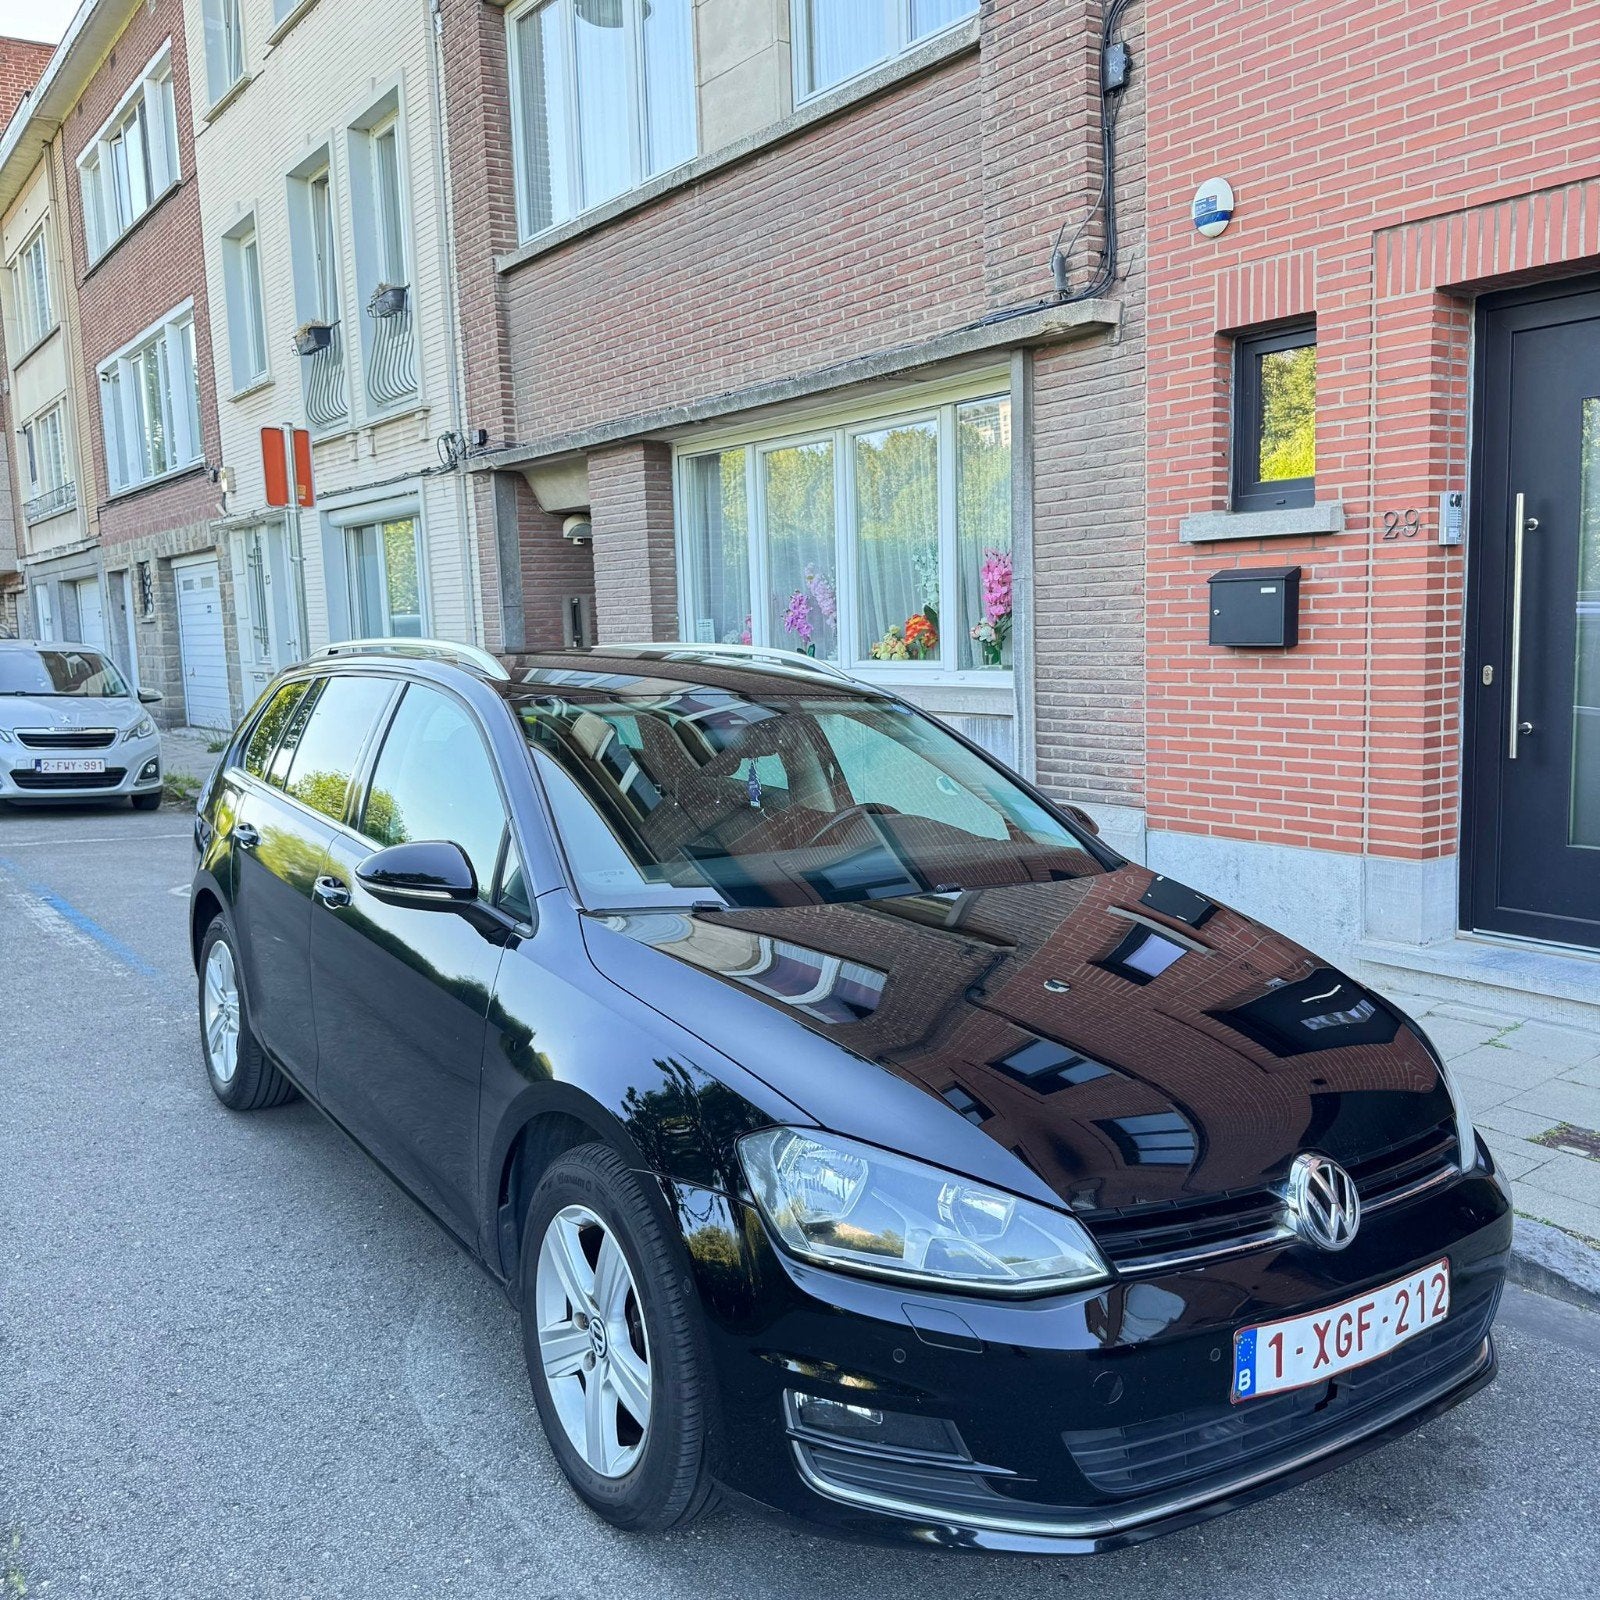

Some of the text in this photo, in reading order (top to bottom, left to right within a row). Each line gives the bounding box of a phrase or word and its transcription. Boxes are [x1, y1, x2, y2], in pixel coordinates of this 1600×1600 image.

[1383, 509, 1419, 540] 29
[1297, 1155, 1360, 1251] VW
[1268, 1272, 1446, 1379] 1-XGF-212
[1238, 1368, 1251, 1391] B
